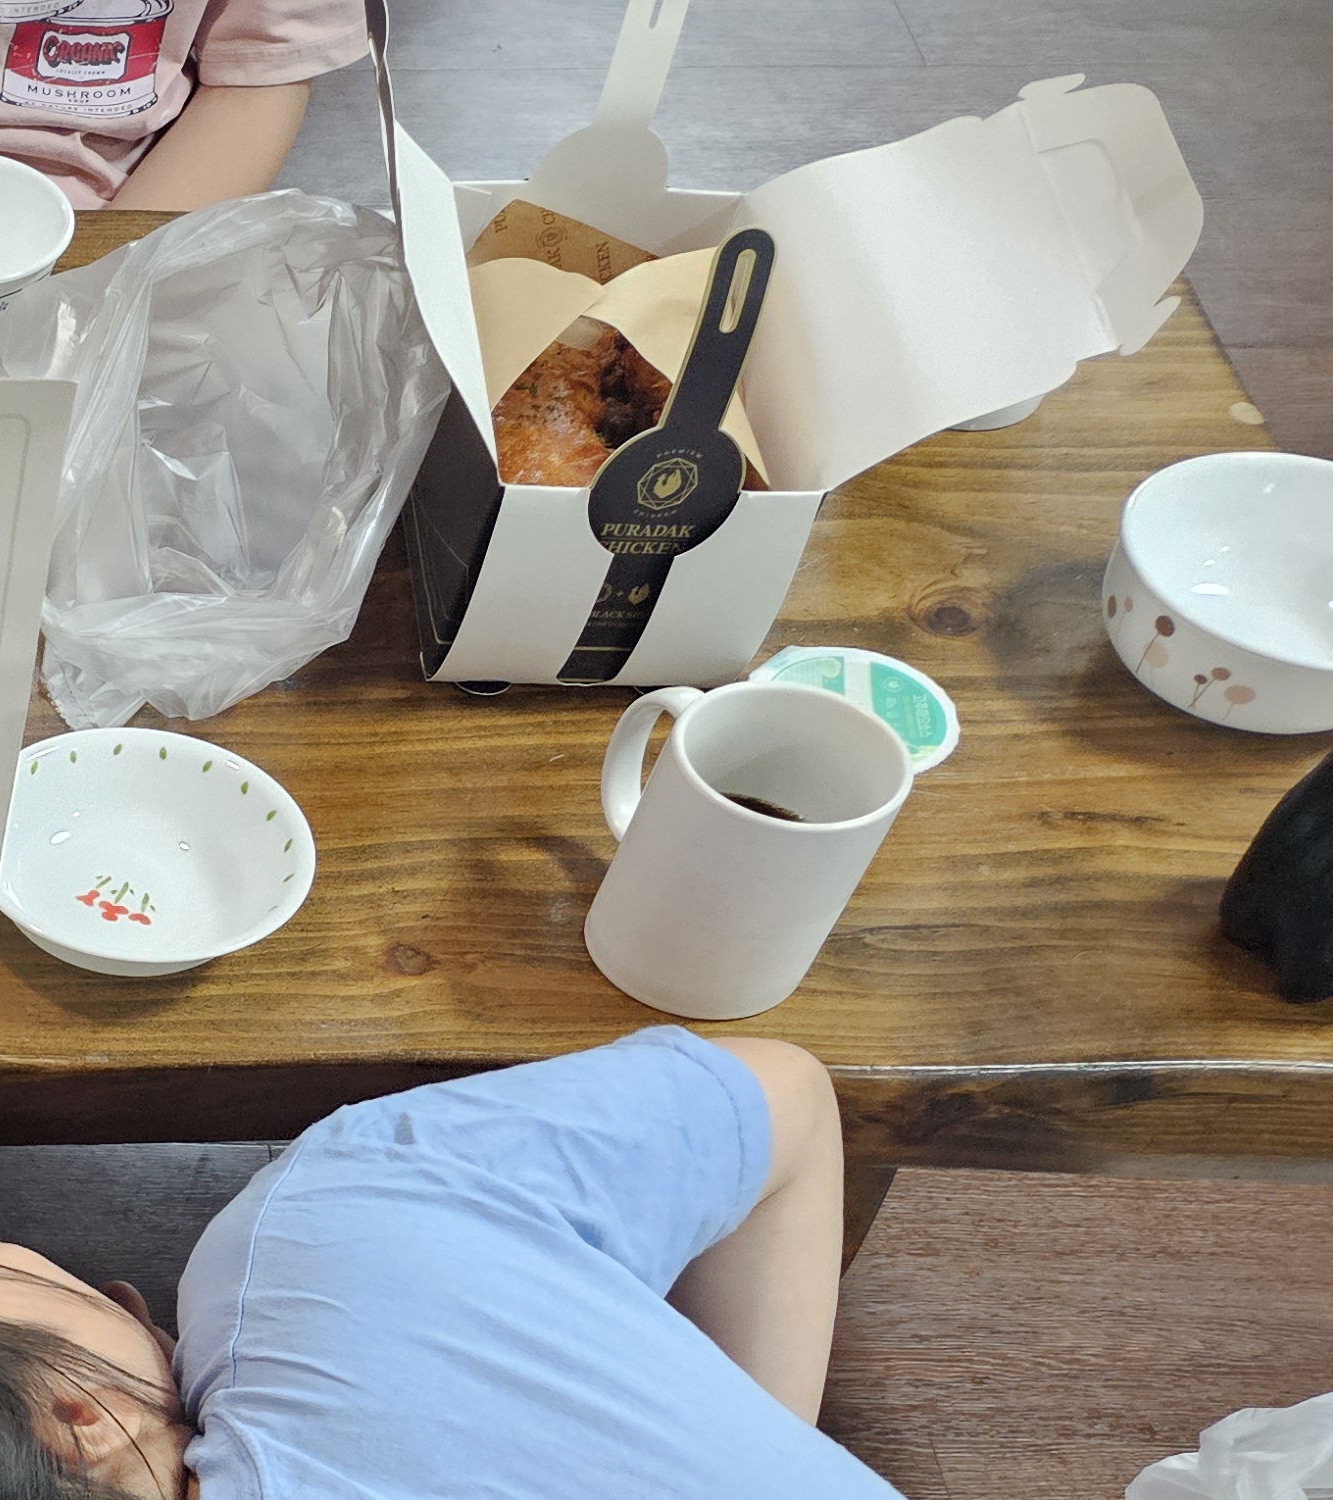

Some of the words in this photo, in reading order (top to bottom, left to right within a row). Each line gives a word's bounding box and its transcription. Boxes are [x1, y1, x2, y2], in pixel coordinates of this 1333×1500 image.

[8, 4, 60, 14] INTENDED
[43, 35, 126, 68] ORGANIC
[28, 85, 132, 99] MUSHROOM
[84, 104, 133, 113] INTENDED
[601, 523, 696, 538] PURADAK
